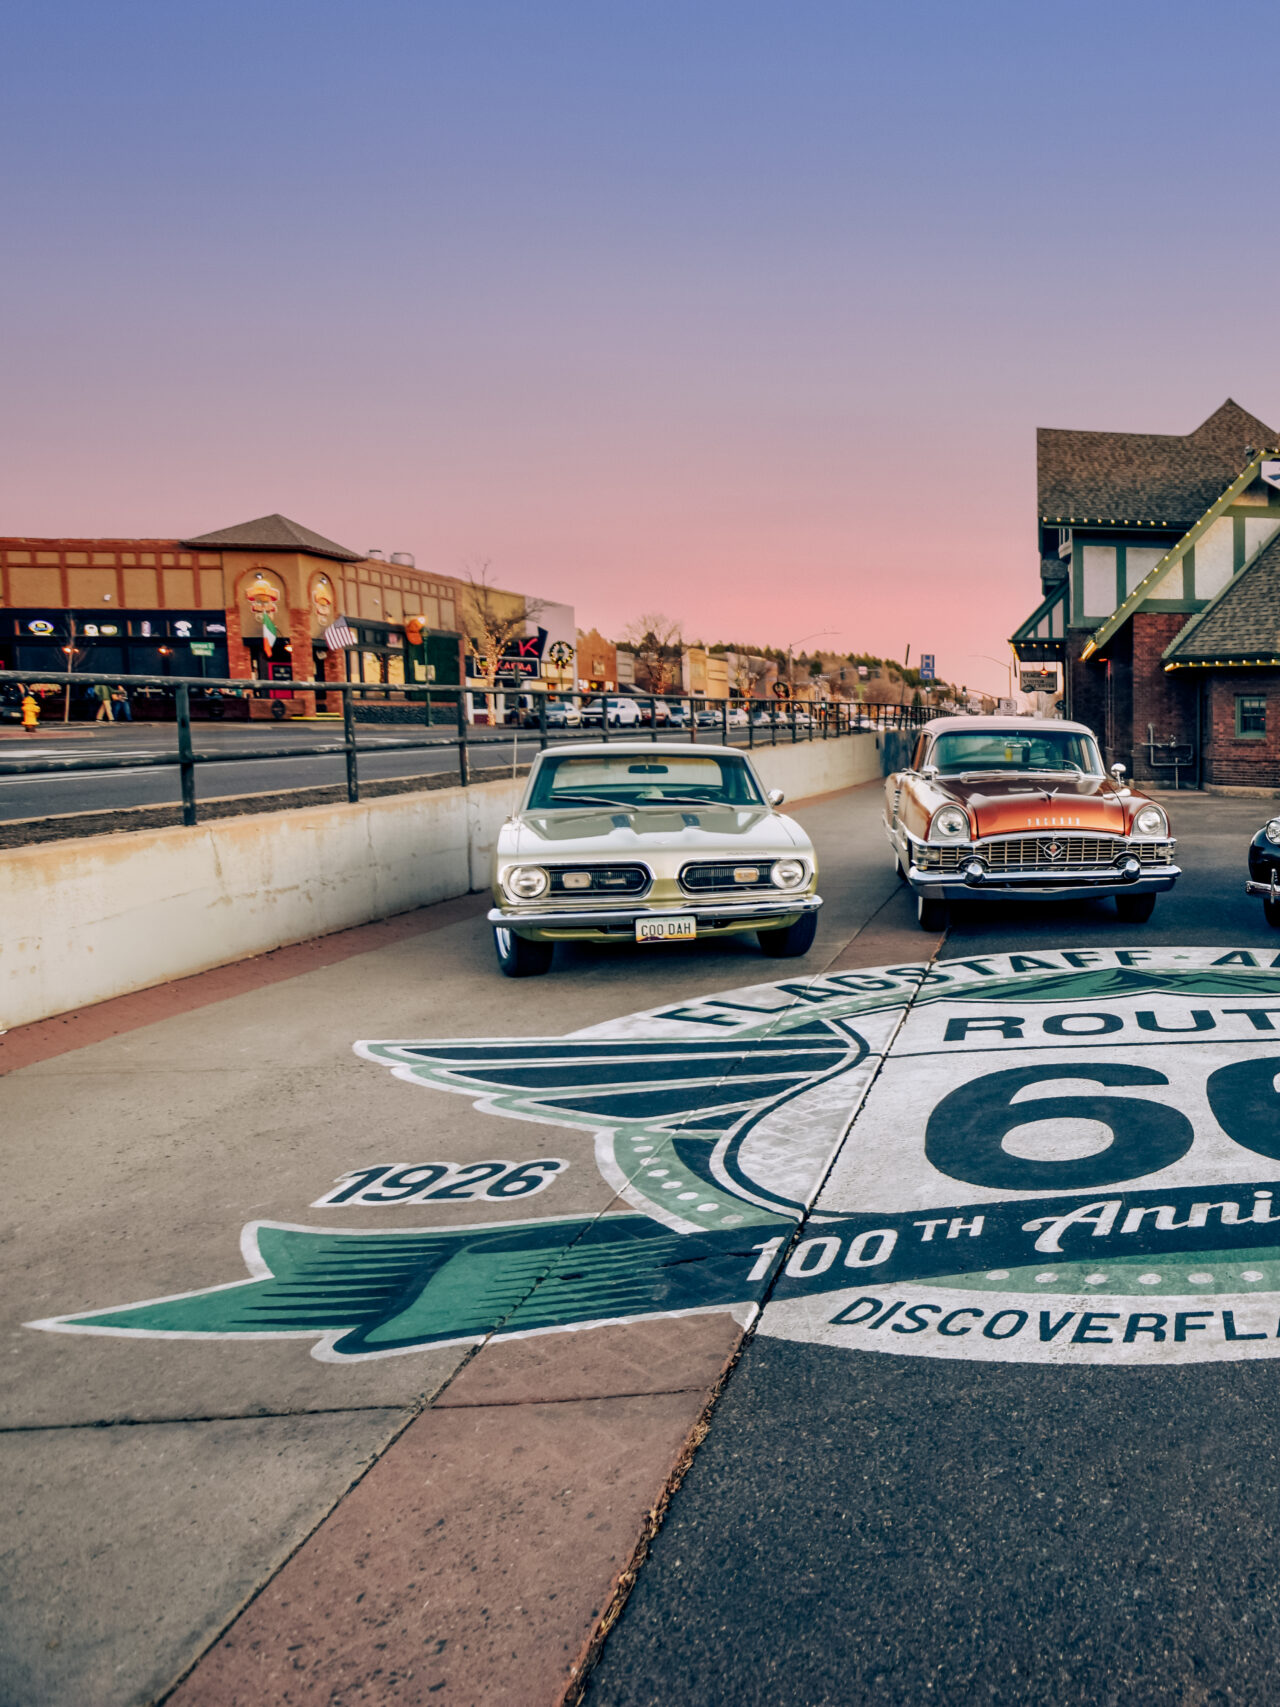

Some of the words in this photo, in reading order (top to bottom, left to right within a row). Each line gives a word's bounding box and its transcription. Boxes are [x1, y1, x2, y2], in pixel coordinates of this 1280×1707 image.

[518, 638, 539, 656] K
[922, 655, 933, 668] H
[668, 922, 691, 935] DAH
[653, 949, 1154, 1026] FLAGSTAFF
[324, 1160, 562, 1204] 1926
